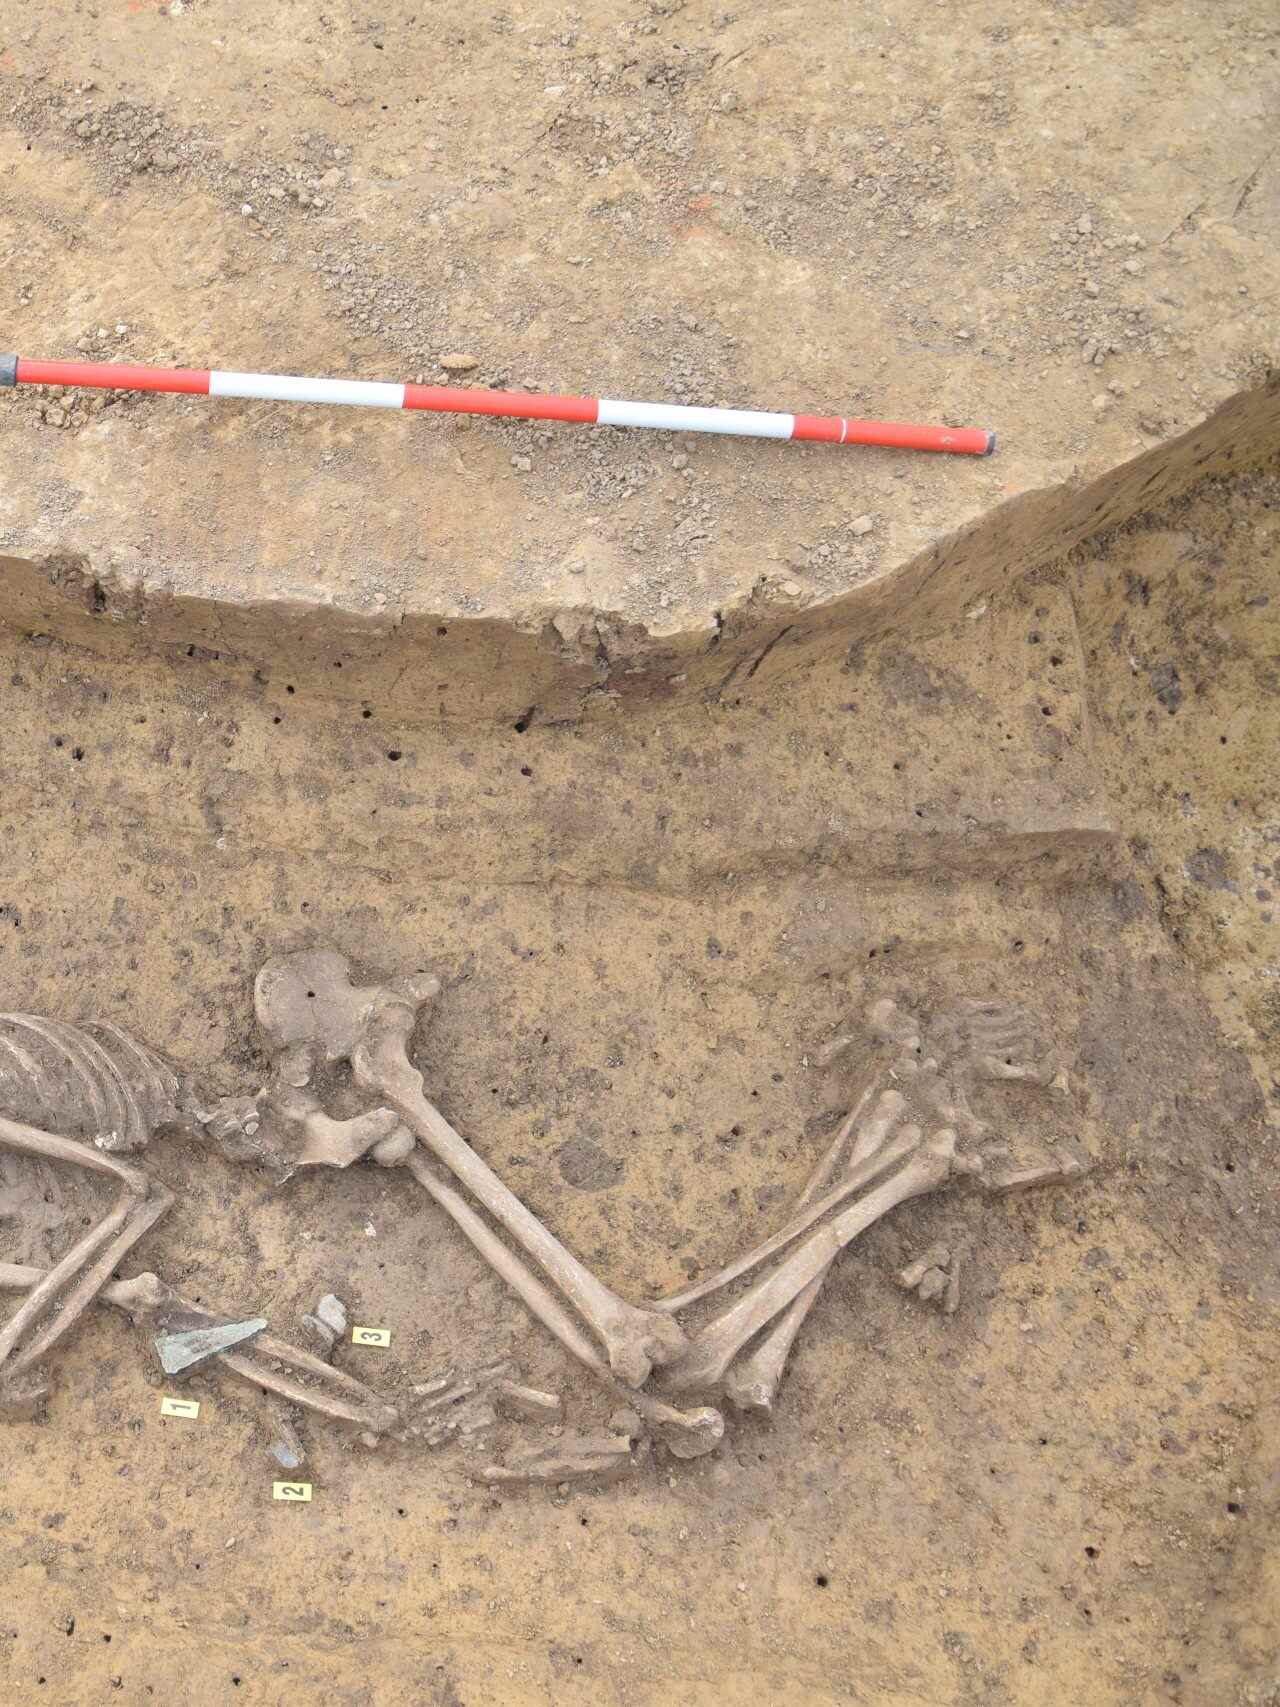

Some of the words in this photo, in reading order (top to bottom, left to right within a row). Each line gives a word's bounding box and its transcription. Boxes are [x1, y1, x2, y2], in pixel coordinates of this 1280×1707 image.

[361, 1331, 382, 1342] 3
[171, 1403, 192, 1411] 1
[282, 1486, 304, 1496] 2
